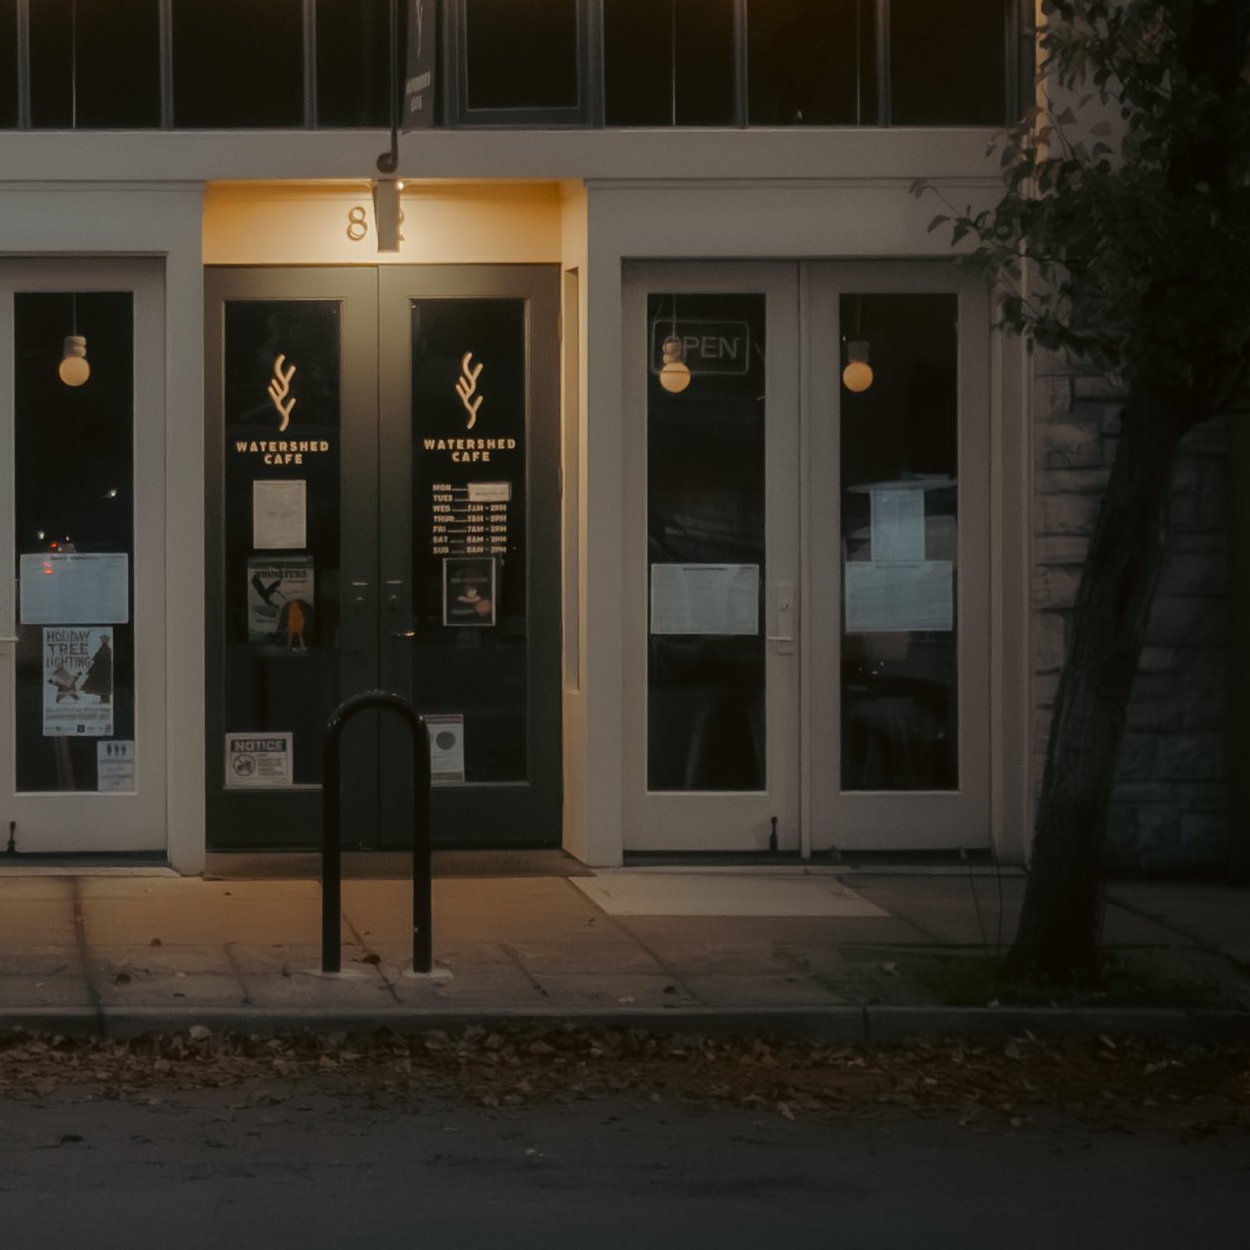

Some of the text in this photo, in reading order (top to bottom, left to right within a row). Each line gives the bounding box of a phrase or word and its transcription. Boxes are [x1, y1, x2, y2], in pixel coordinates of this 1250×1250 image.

[662, 335, 741, 359] OPEN
[236, 441, 329, 452] WATERSHED
[424, 438, 516, 450] WATERSHED
[264, 454, 303, 464] CAFE
[452, 451, 491, 462] CAFE
[46, 630, 90, 642] HOLIDAY
[47, 643, 89, 655] TREE
[46, 657, 91, 669] LIGHTING
[234, 740, 283, 751] NOTICE
